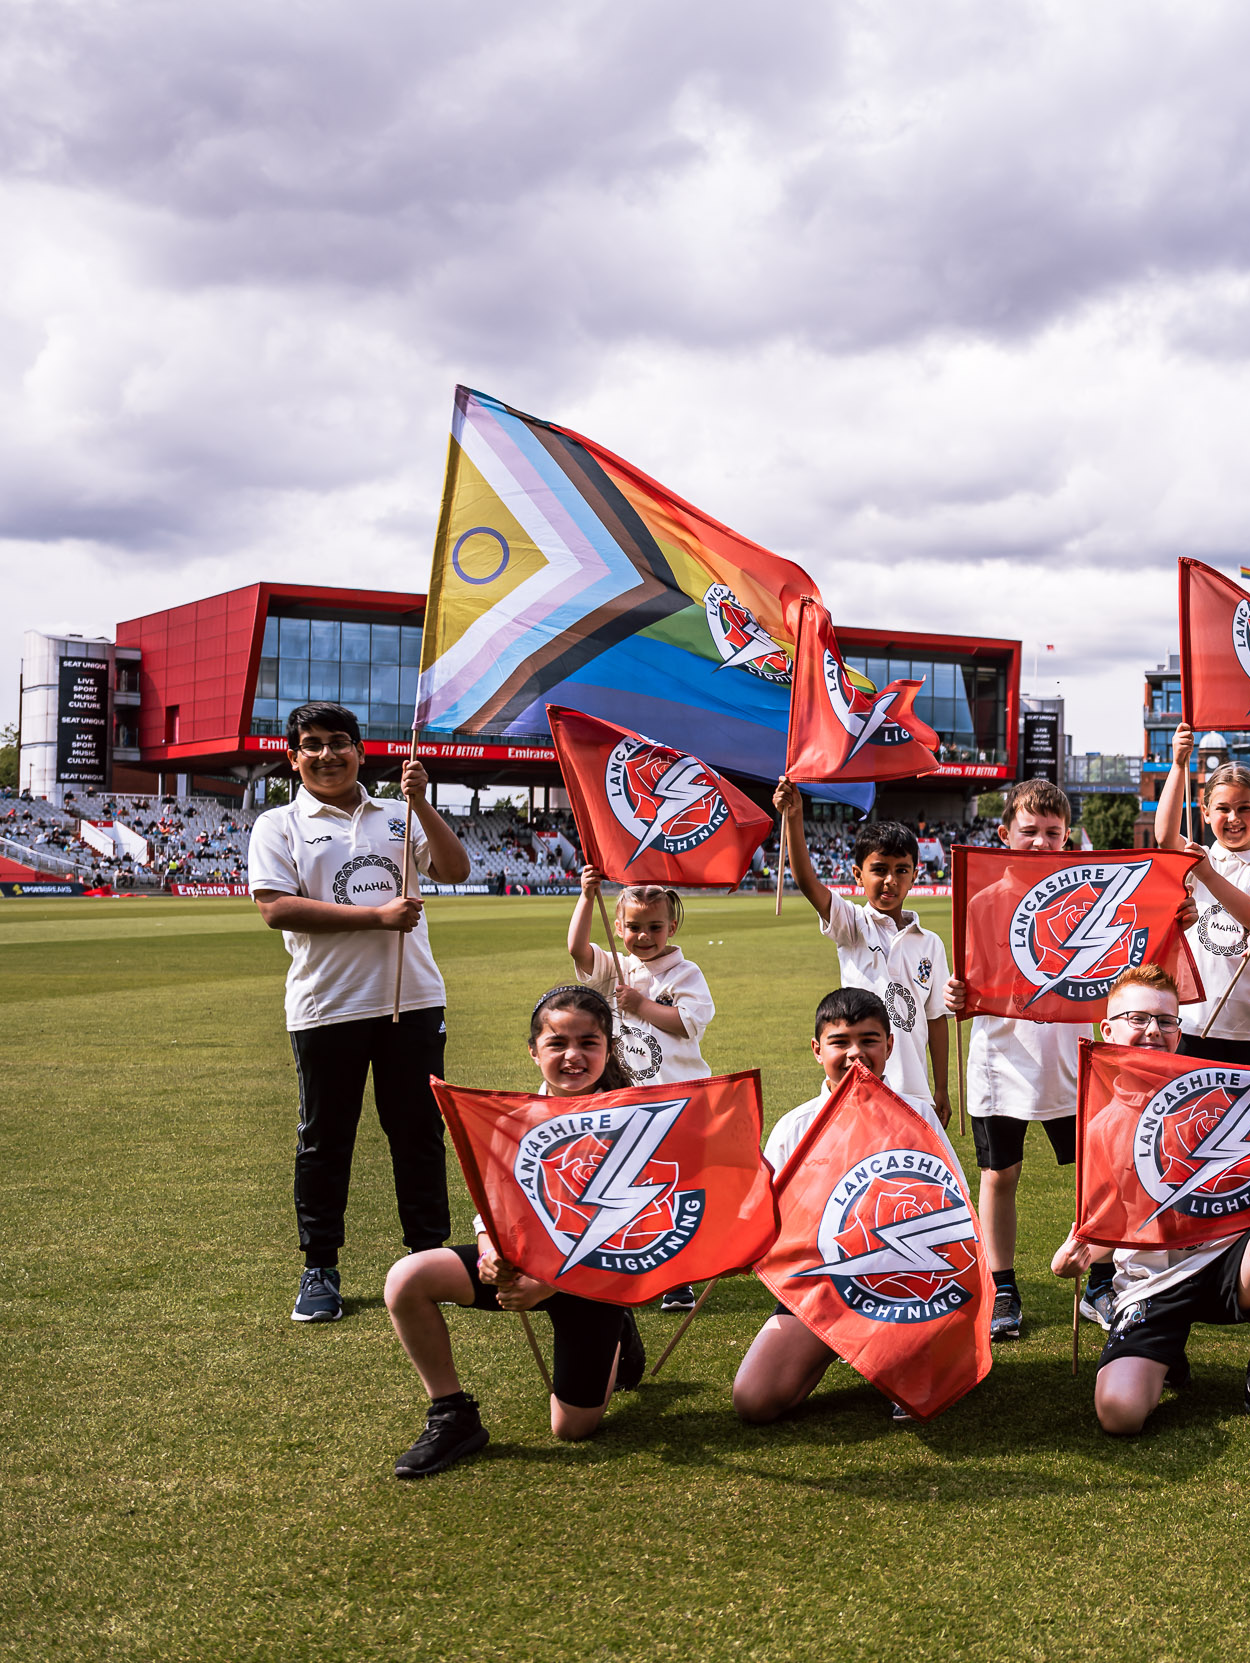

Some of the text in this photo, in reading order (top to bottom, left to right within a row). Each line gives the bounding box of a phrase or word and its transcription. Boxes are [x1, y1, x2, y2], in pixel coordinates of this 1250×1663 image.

[63, 660, 107, 671] SEAT UNIQUE
[77, 677, 95, 685] LIVE
[73, 693, 97, 701] MUSIC
[68, 701, 101, 709] CULTURE
[61, 716, 105, 726] SEAT UNIQUE
[75, 733, 94, 741] LIVE
[71, 741, 97, 749] SPORT
[387, 742, 484, 757] Emiates FLY BETTER
[72, 749, 96, 757] MUSIC
[508, 748, 555, 760] Emirates
[66, 757, 100, 765] CULTURE
[60, 772, 104, 781] SEAT UNIQUE
[234, 885, 246, 896] FLY
[352, 880, 393, 894] MAHAL
[1014, 868, 1105, 948] LANCASHIRE
[1210, 921, 1241, 934] MAHAL
[1138, 1072, 1241, 1158] LANCASHIRE
[524, 1113, 612, 1201] LANCASHIRE
[834, 1155, 962, 1206] LANCASHIRE
[601, 1199, 701, 1271] LIGHTNING
[843, 1281, 962, 1320] LIGHTNING
